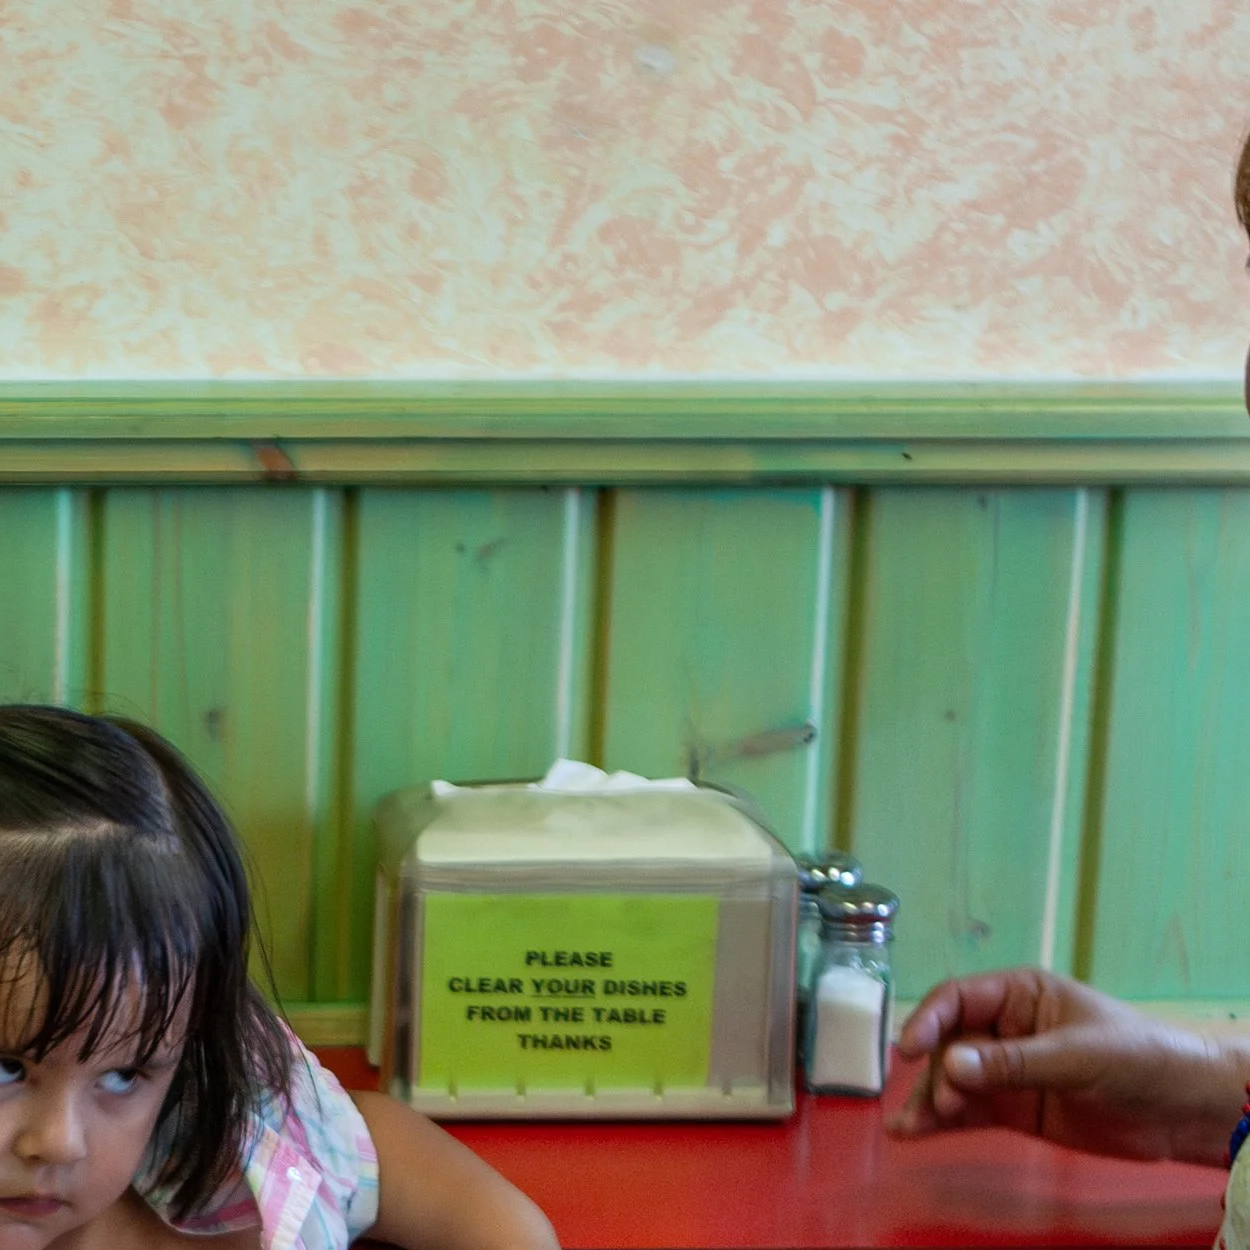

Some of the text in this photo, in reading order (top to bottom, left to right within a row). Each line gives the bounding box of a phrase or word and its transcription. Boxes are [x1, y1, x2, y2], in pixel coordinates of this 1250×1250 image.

[525, 950, 614, 968] PLEASE
[447, 977, 688, 997] CLEAR YOUR DISHES
[466, 1005, 667, 1024] FROM THE TABLE
[517, 1033, 613, 1051] THANKS
